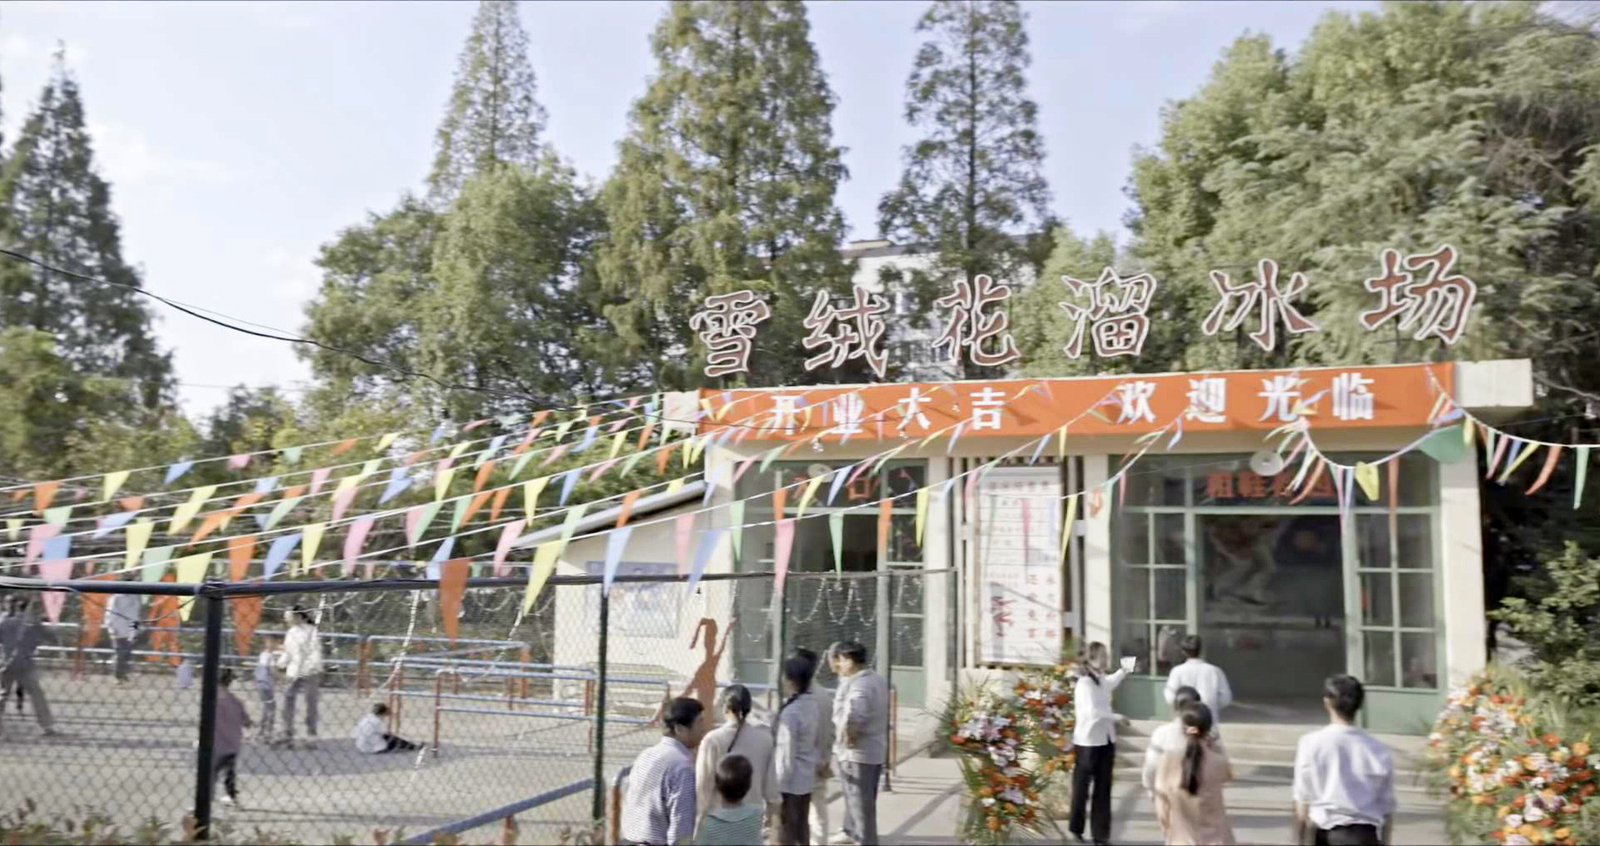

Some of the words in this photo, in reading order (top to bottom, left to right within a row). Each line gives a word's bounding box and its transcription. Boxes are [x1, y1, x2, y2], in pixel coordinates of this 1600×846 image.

[689, 244, 1477, 378] 雪绒花溜冰场
[771, 387, 1005, 435] 开业大吉
[1116, 372, 1375, 423] 欢迎光临
